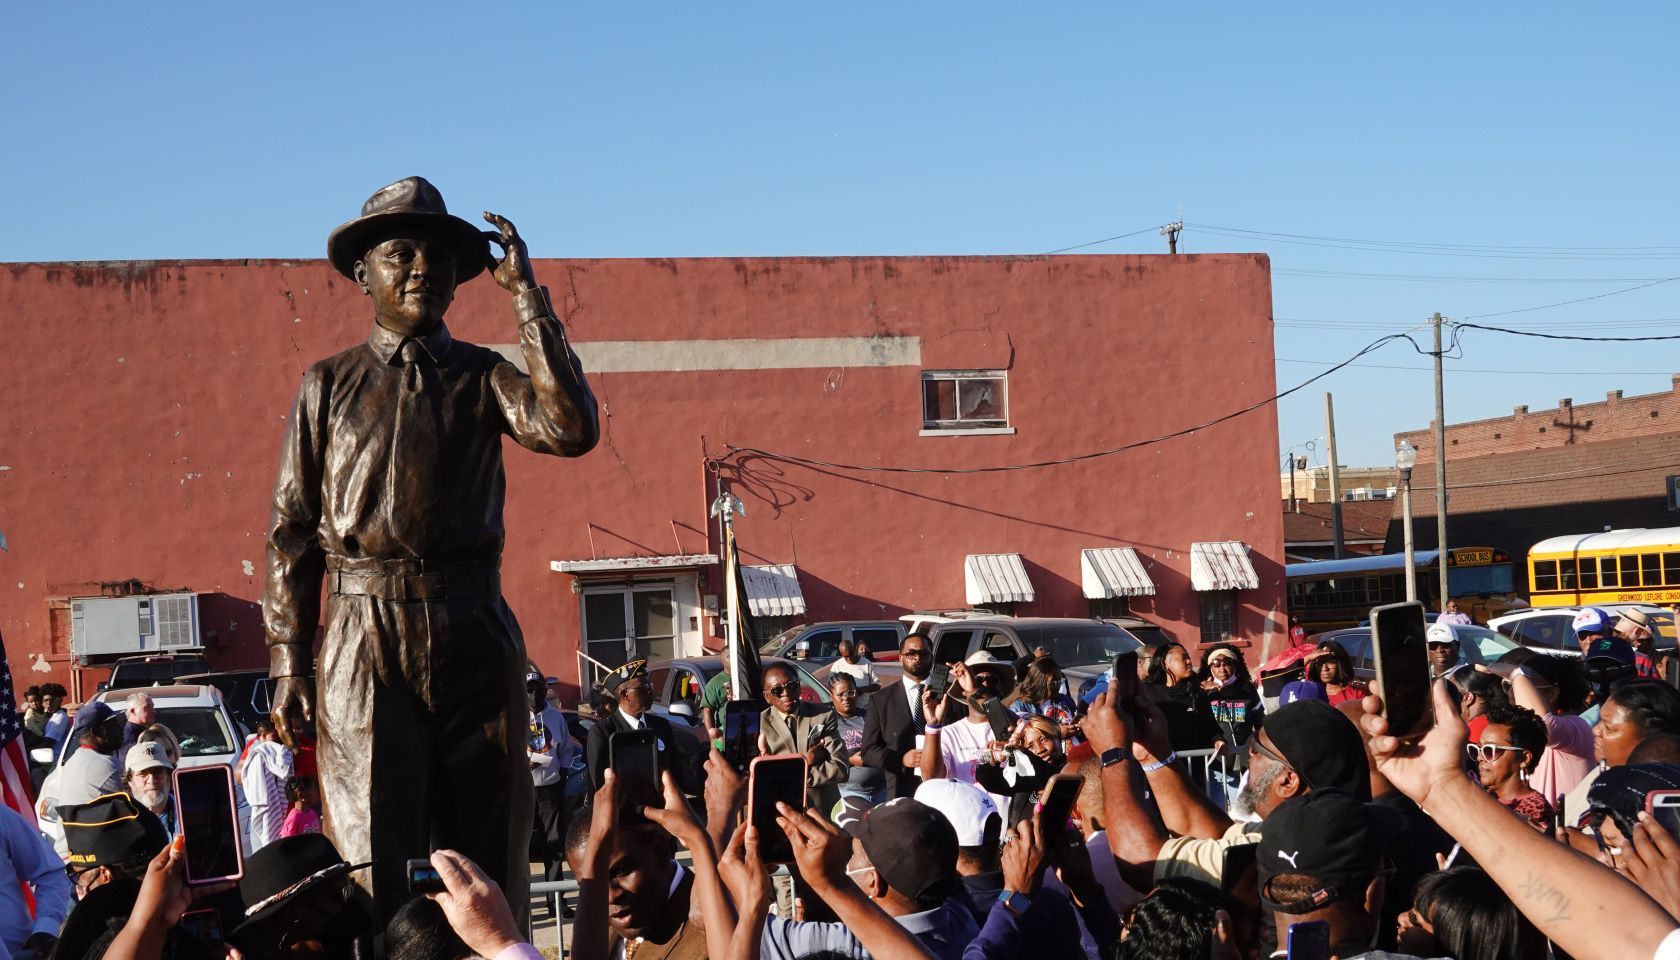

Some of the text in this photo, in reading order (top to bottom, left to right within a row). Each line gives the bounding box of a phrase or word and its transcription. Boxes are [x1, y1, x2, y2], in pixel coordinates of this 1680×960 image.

[1457, 551, 1490, 562] SCHOOL BUS
[1618, 594, 1642, 602] GREENWOOD
[1645, 592, 1663, 601] LEFLORE
[1288, 691, 1298, 702] LA
